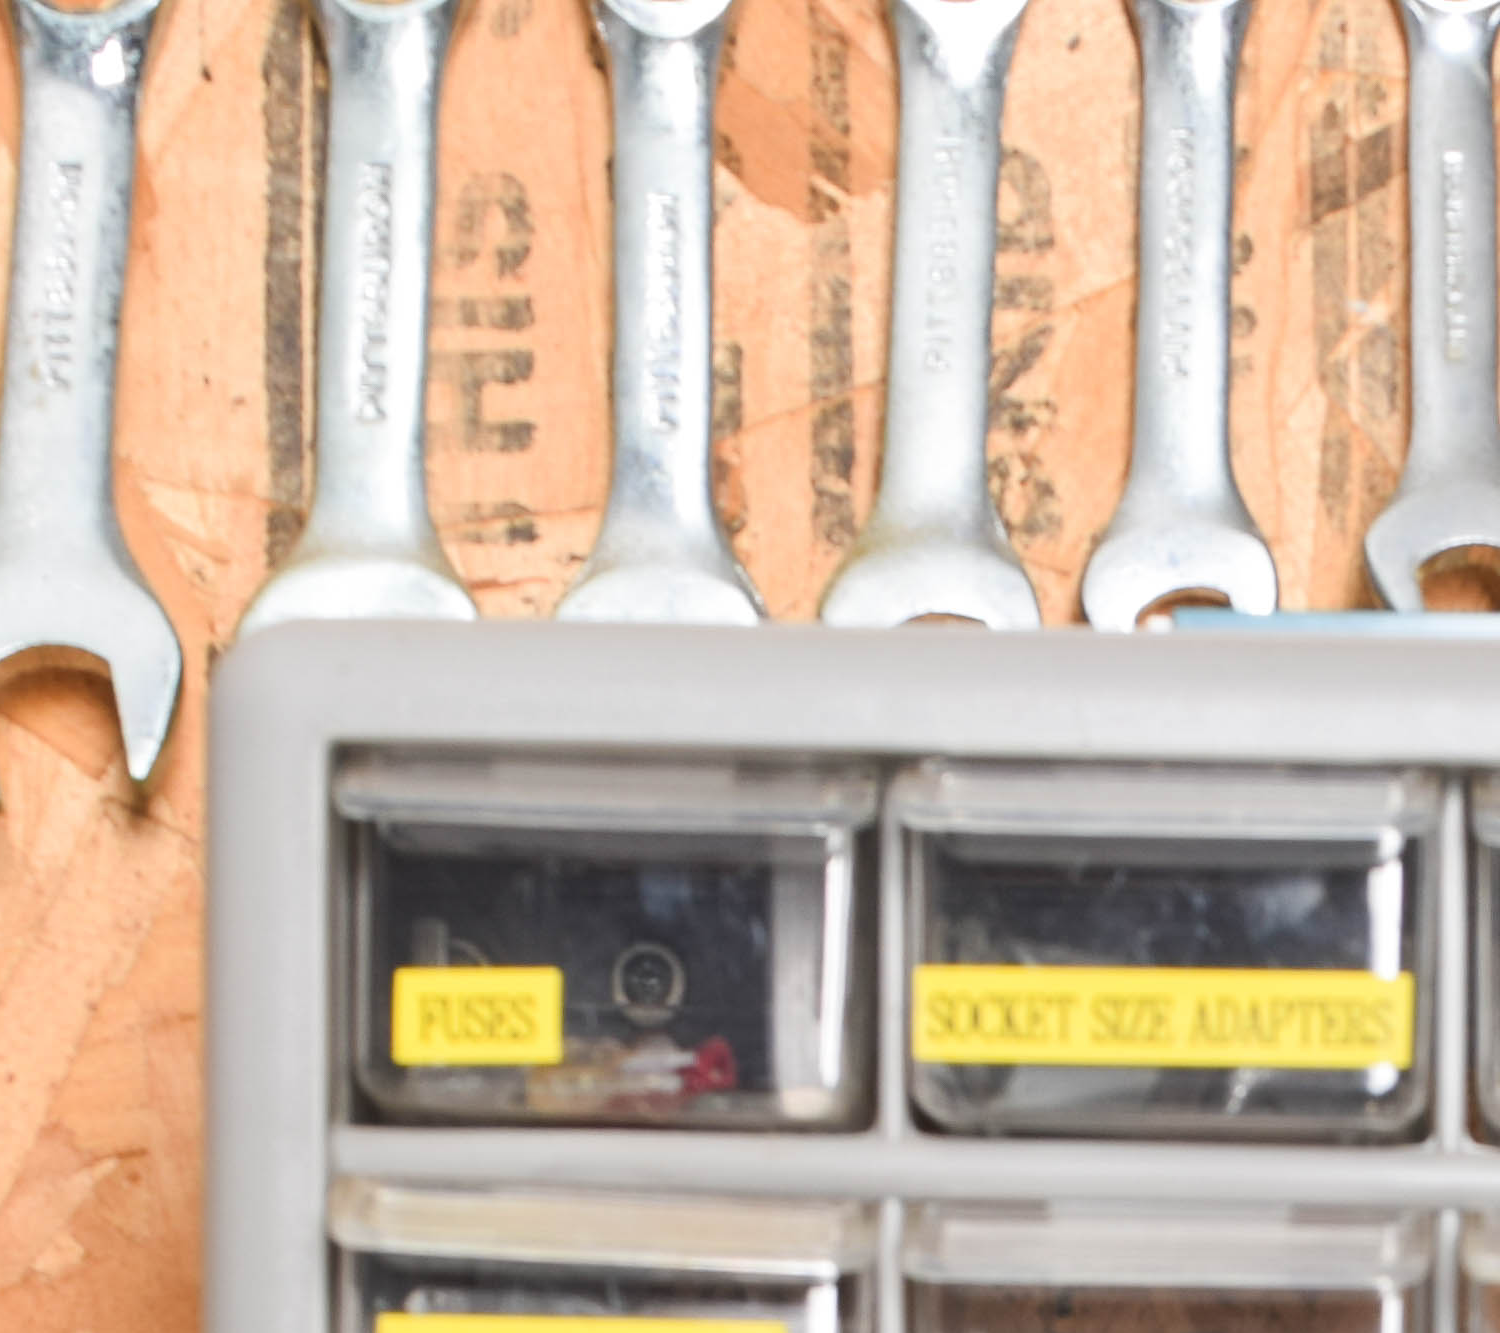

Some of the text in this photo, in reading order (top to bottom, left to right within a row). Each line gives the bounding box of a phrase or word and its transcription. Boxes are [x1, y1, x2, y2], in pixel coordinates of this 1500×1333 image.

[417, 993, 538, 1042] FUSES
[923, 993, 1395, 1048] SOCKET SIZE ADAPTERS
